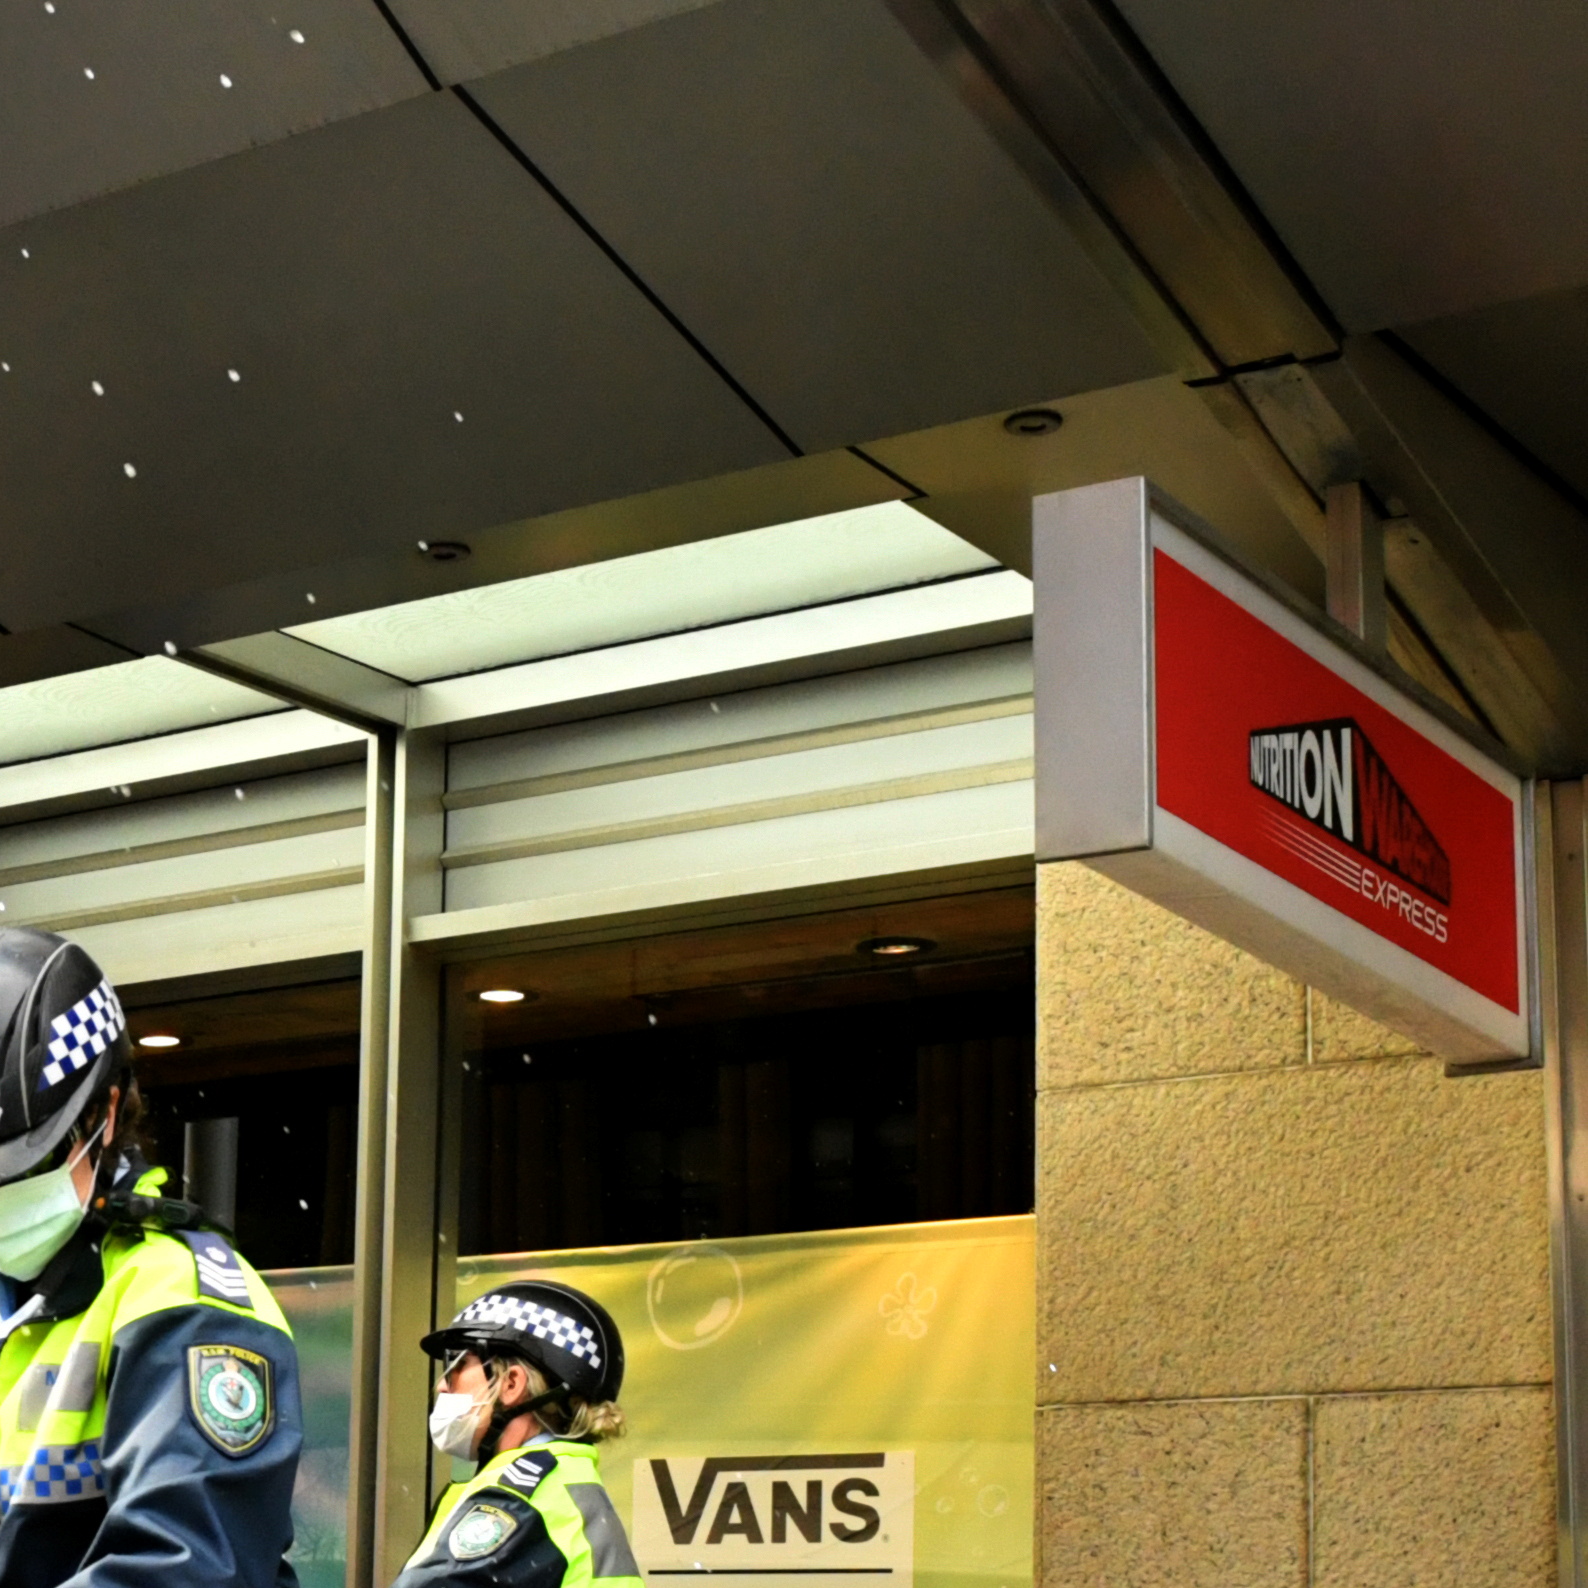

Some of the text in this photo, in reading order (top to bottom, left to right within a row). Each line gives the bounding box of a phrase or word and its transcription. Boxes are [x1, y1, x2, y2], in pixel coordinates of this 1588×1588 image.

[1250, 727, 1354, 843] NUTRITION
[1361, 868, 1449, 943] EXPRESS
[649, 1452, 886, 1545] VANS
